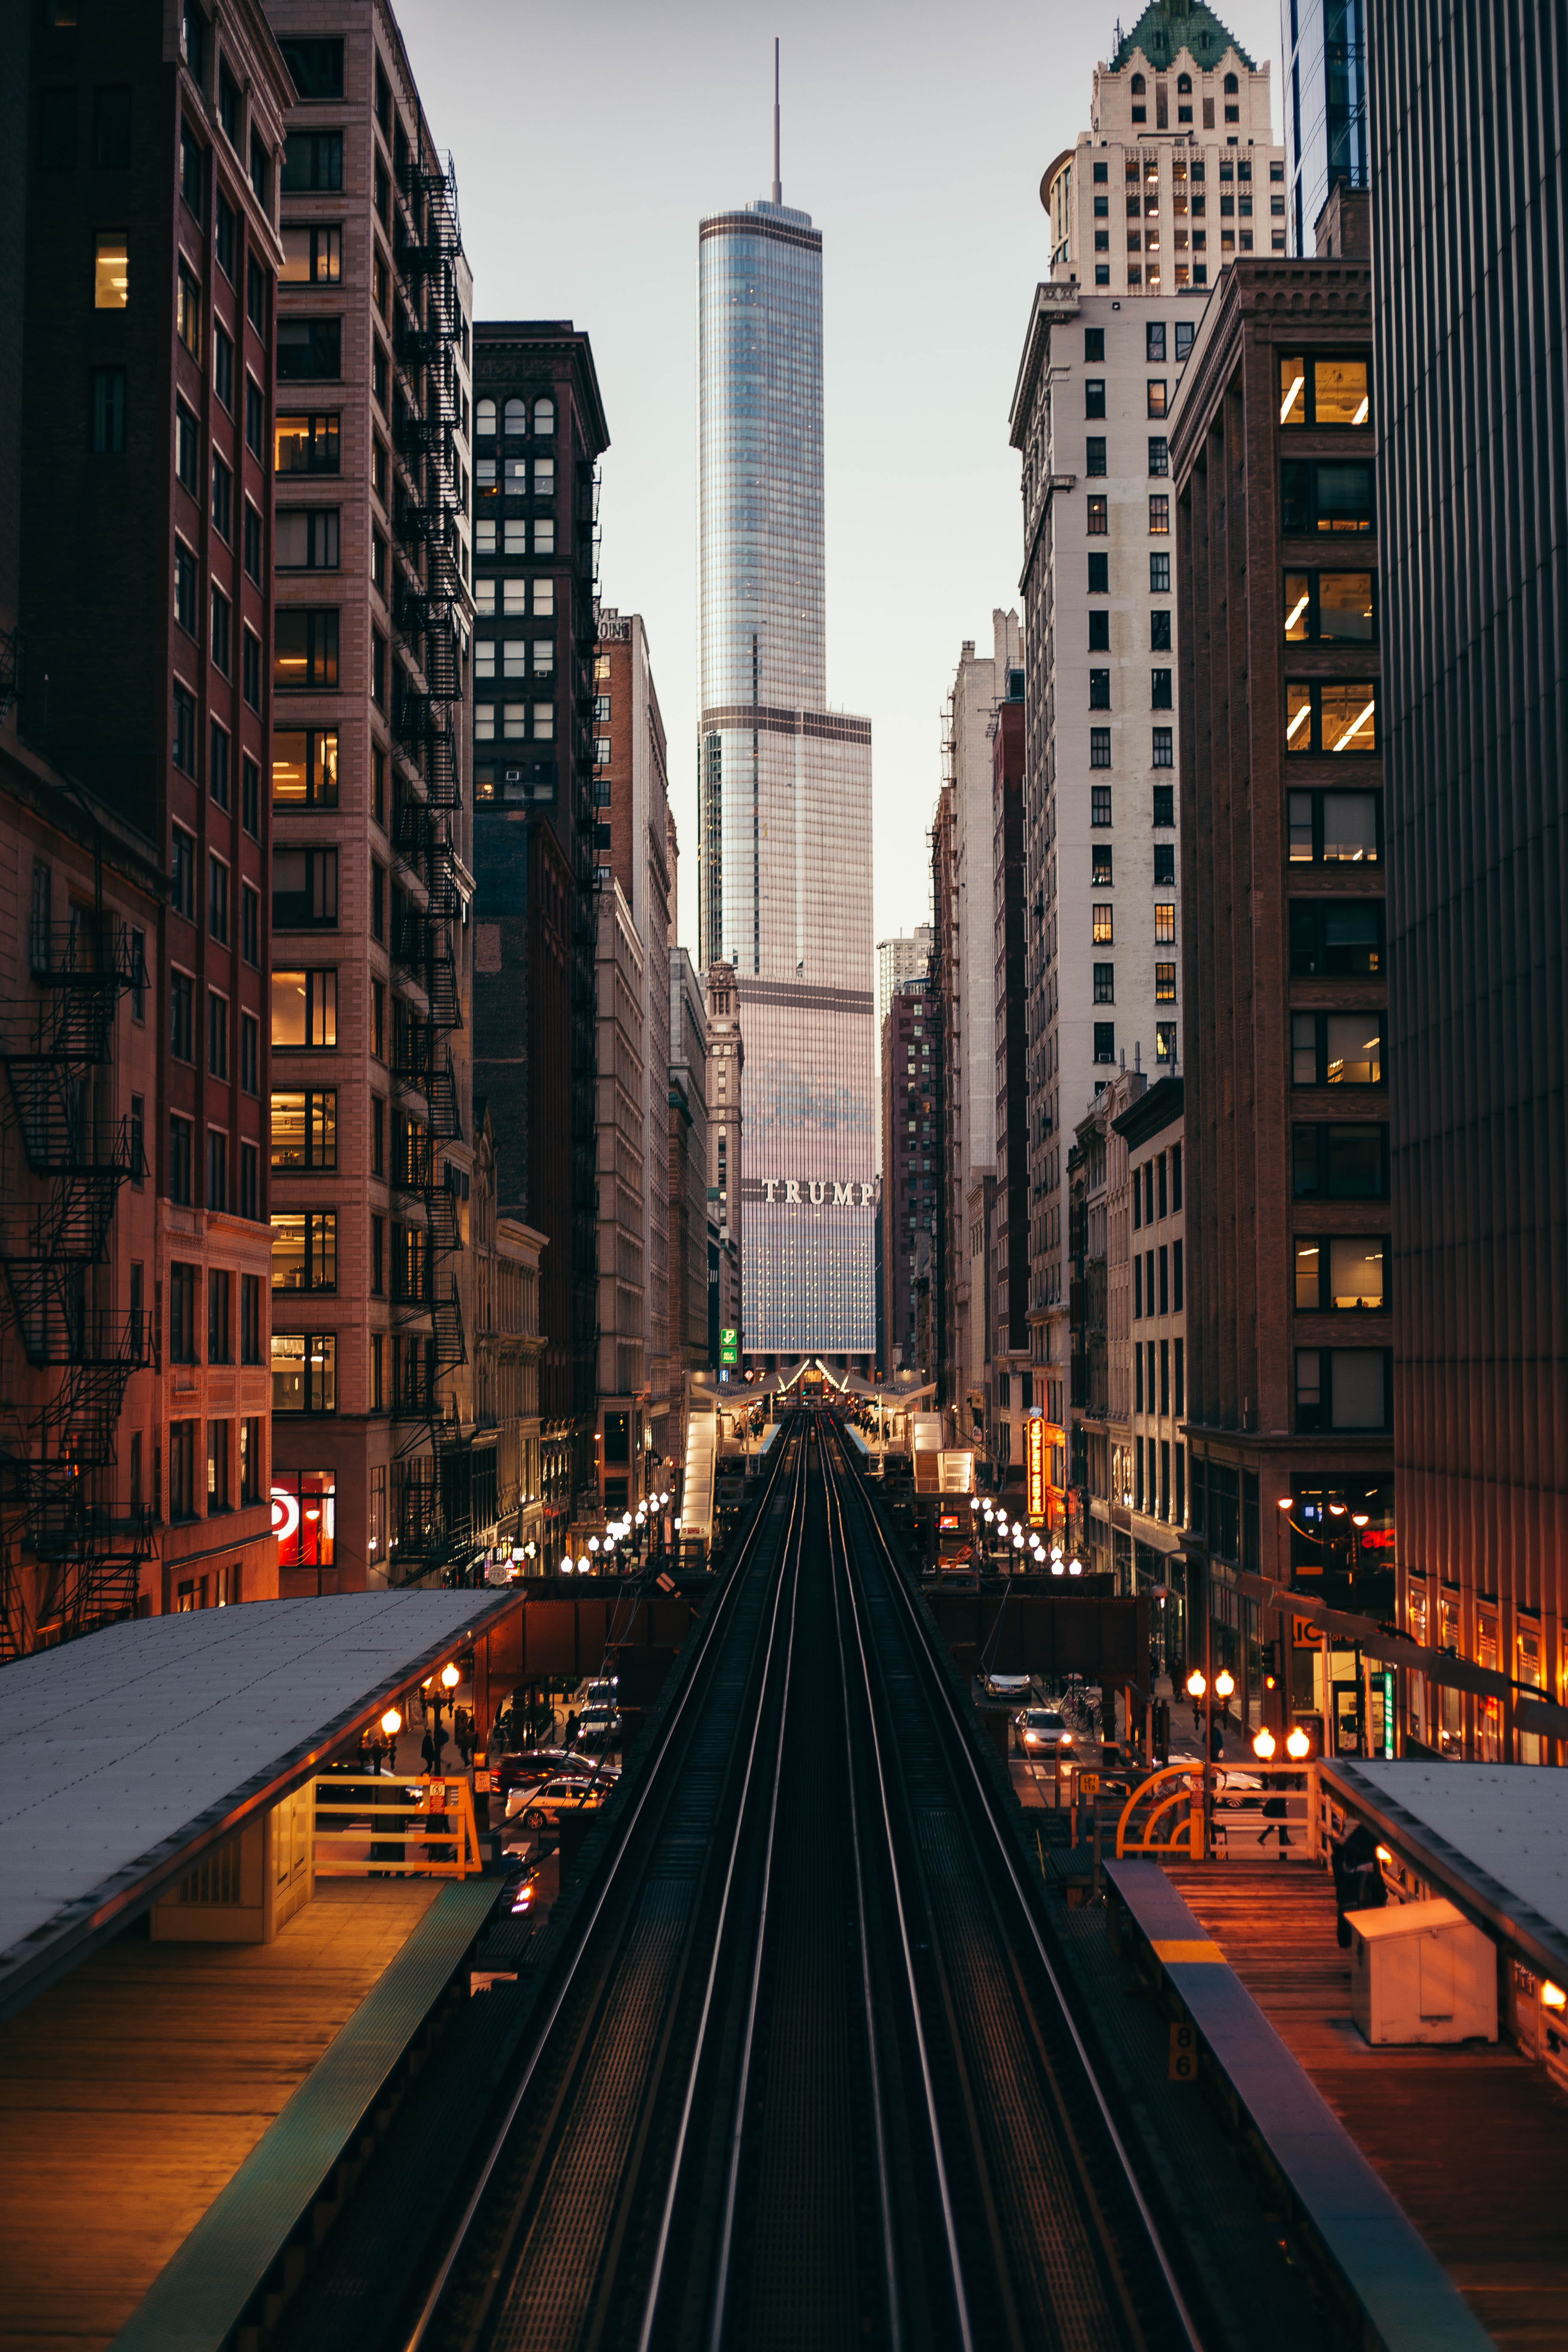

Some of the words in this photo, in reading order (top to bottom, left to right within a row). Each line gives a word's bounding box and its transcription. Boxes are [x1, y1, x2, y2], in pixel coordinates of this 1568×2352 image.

[761, 1178, 875, 1207] TRUMP
[1030, 1420, 1042, 1473] JEWELERS
[1031, 1474, 1042, 1512] CENTER
[491, 1571, 505, 1581] mg
[1292, 1622, 1322, 1642] IC
[1177, 2027, 1192, 2048] 8
[1175, 2055, 1191, 2076] 6
